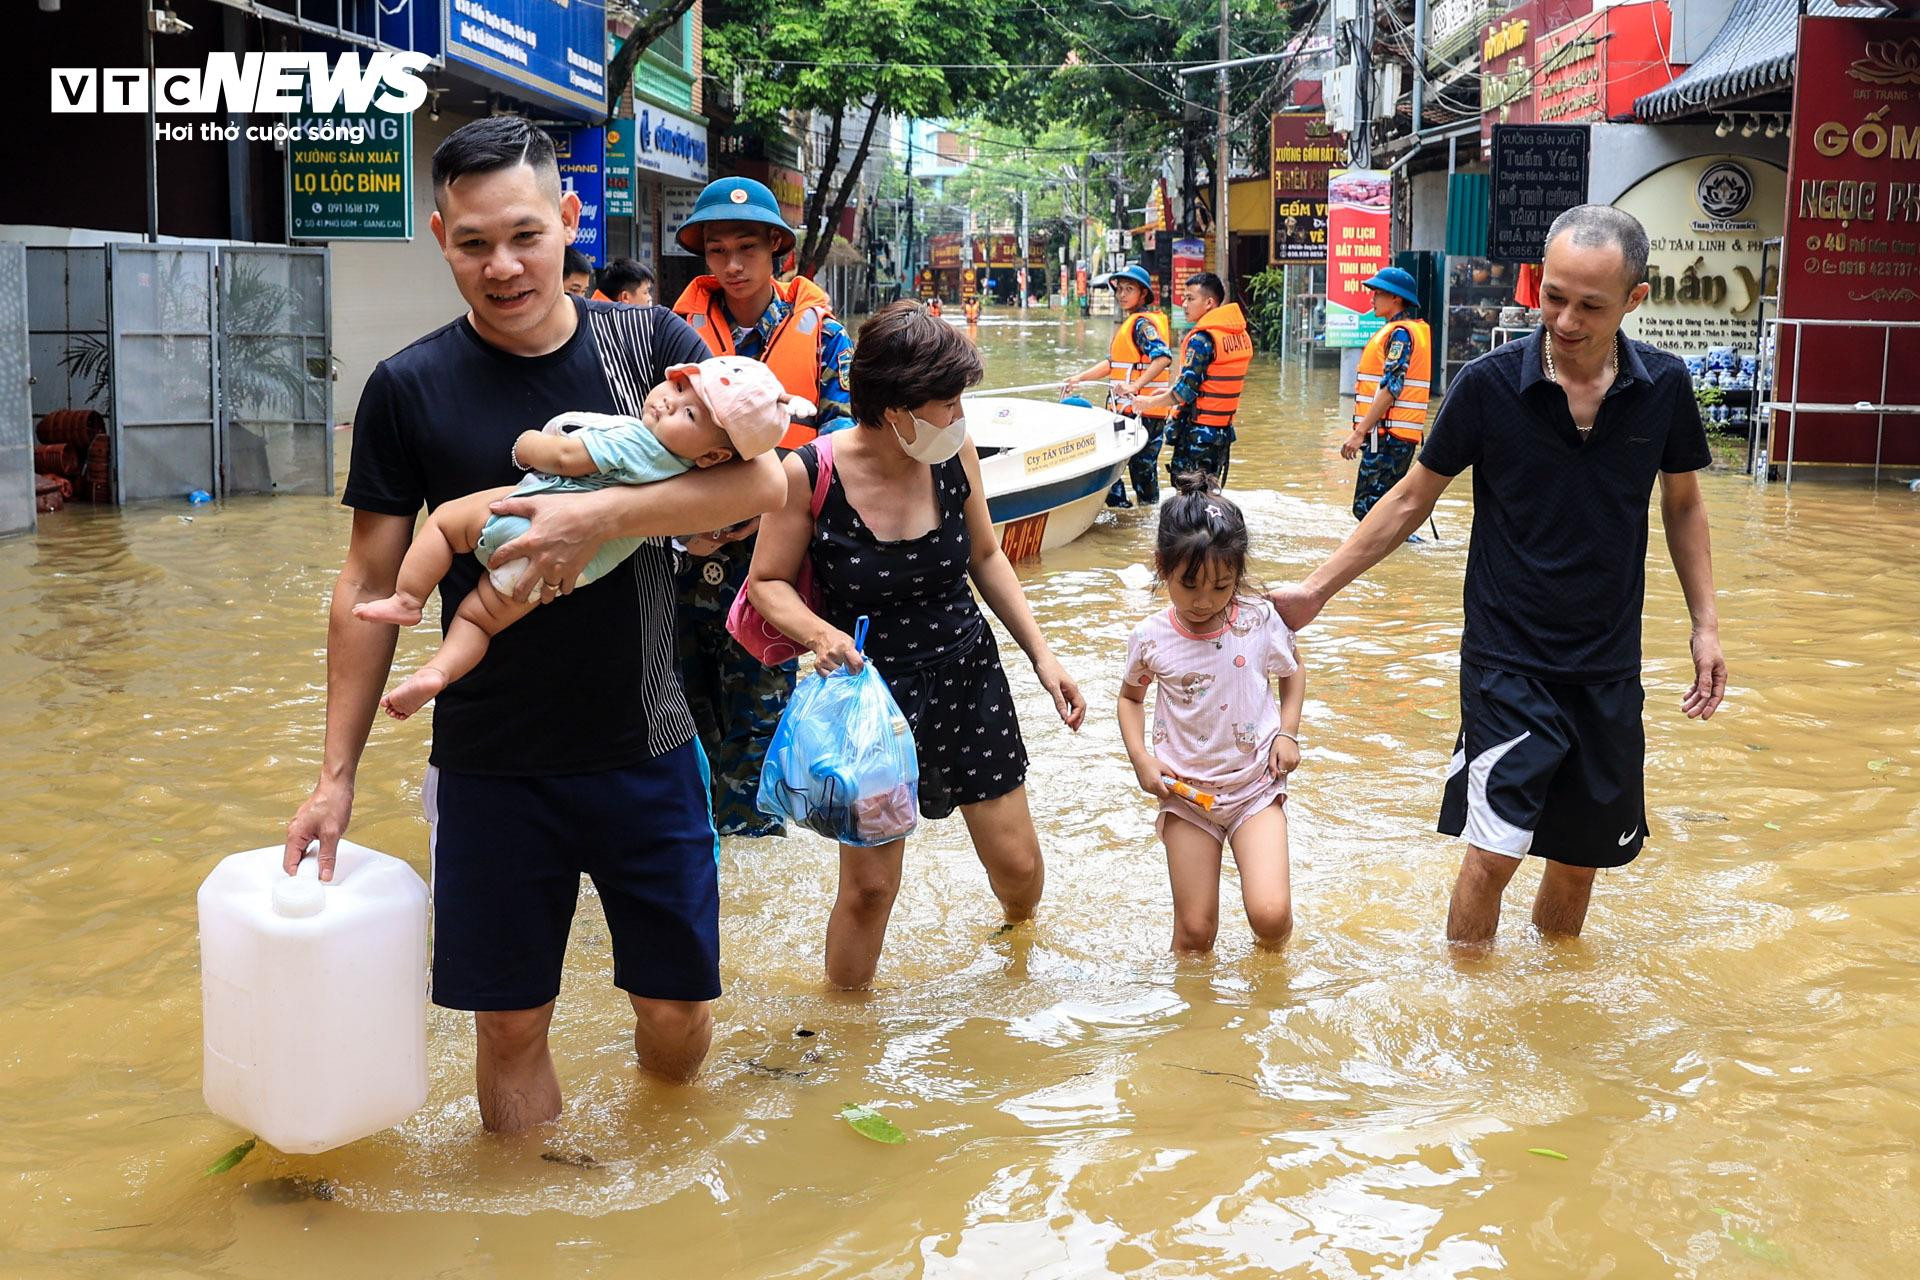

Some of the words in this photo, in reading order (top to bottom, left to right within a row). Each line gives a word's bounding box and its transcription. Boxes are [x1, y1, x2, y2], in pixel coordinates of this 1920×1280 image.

[1536, 133, 1555, 145] SẢN
[1558, 132, 1581, 145] XUẤT
[1813, 105, 1920, 159] GỐM
[339, 148, 365, 164] SẢN
[367, 147, 400, 164] XUẤT
[1504, 148, 1543, 167] Tuấn
[1547, 148, 1578, 167] Yến
[559, 164, 599, 174] KHANG
[294, 173, 317, 196] LỌ
[320, 169, 354, 196] LỘC
[357, 169, 401, 193] BÌNH
[364, 203, 380, 214] 179
[1280, 200, 1311, 217] GỐM
[1799, 179, 1877, 229] NGỌC
[1342, 226, 1355, 239] DU
[1356, 226, 1376, 242] LỊCH
[1824, 233, 1846, 251] 40
[1669, 238, 1694, 251] TÂM
[1698, 240, 1725, 251] LINH
[1731, 239, 1743, 251] &
[1338, 262, 1359, 275] TINH
[1343, 278, 1359, 295] HỘI
[1026, 454, 1041, 467] Cty
